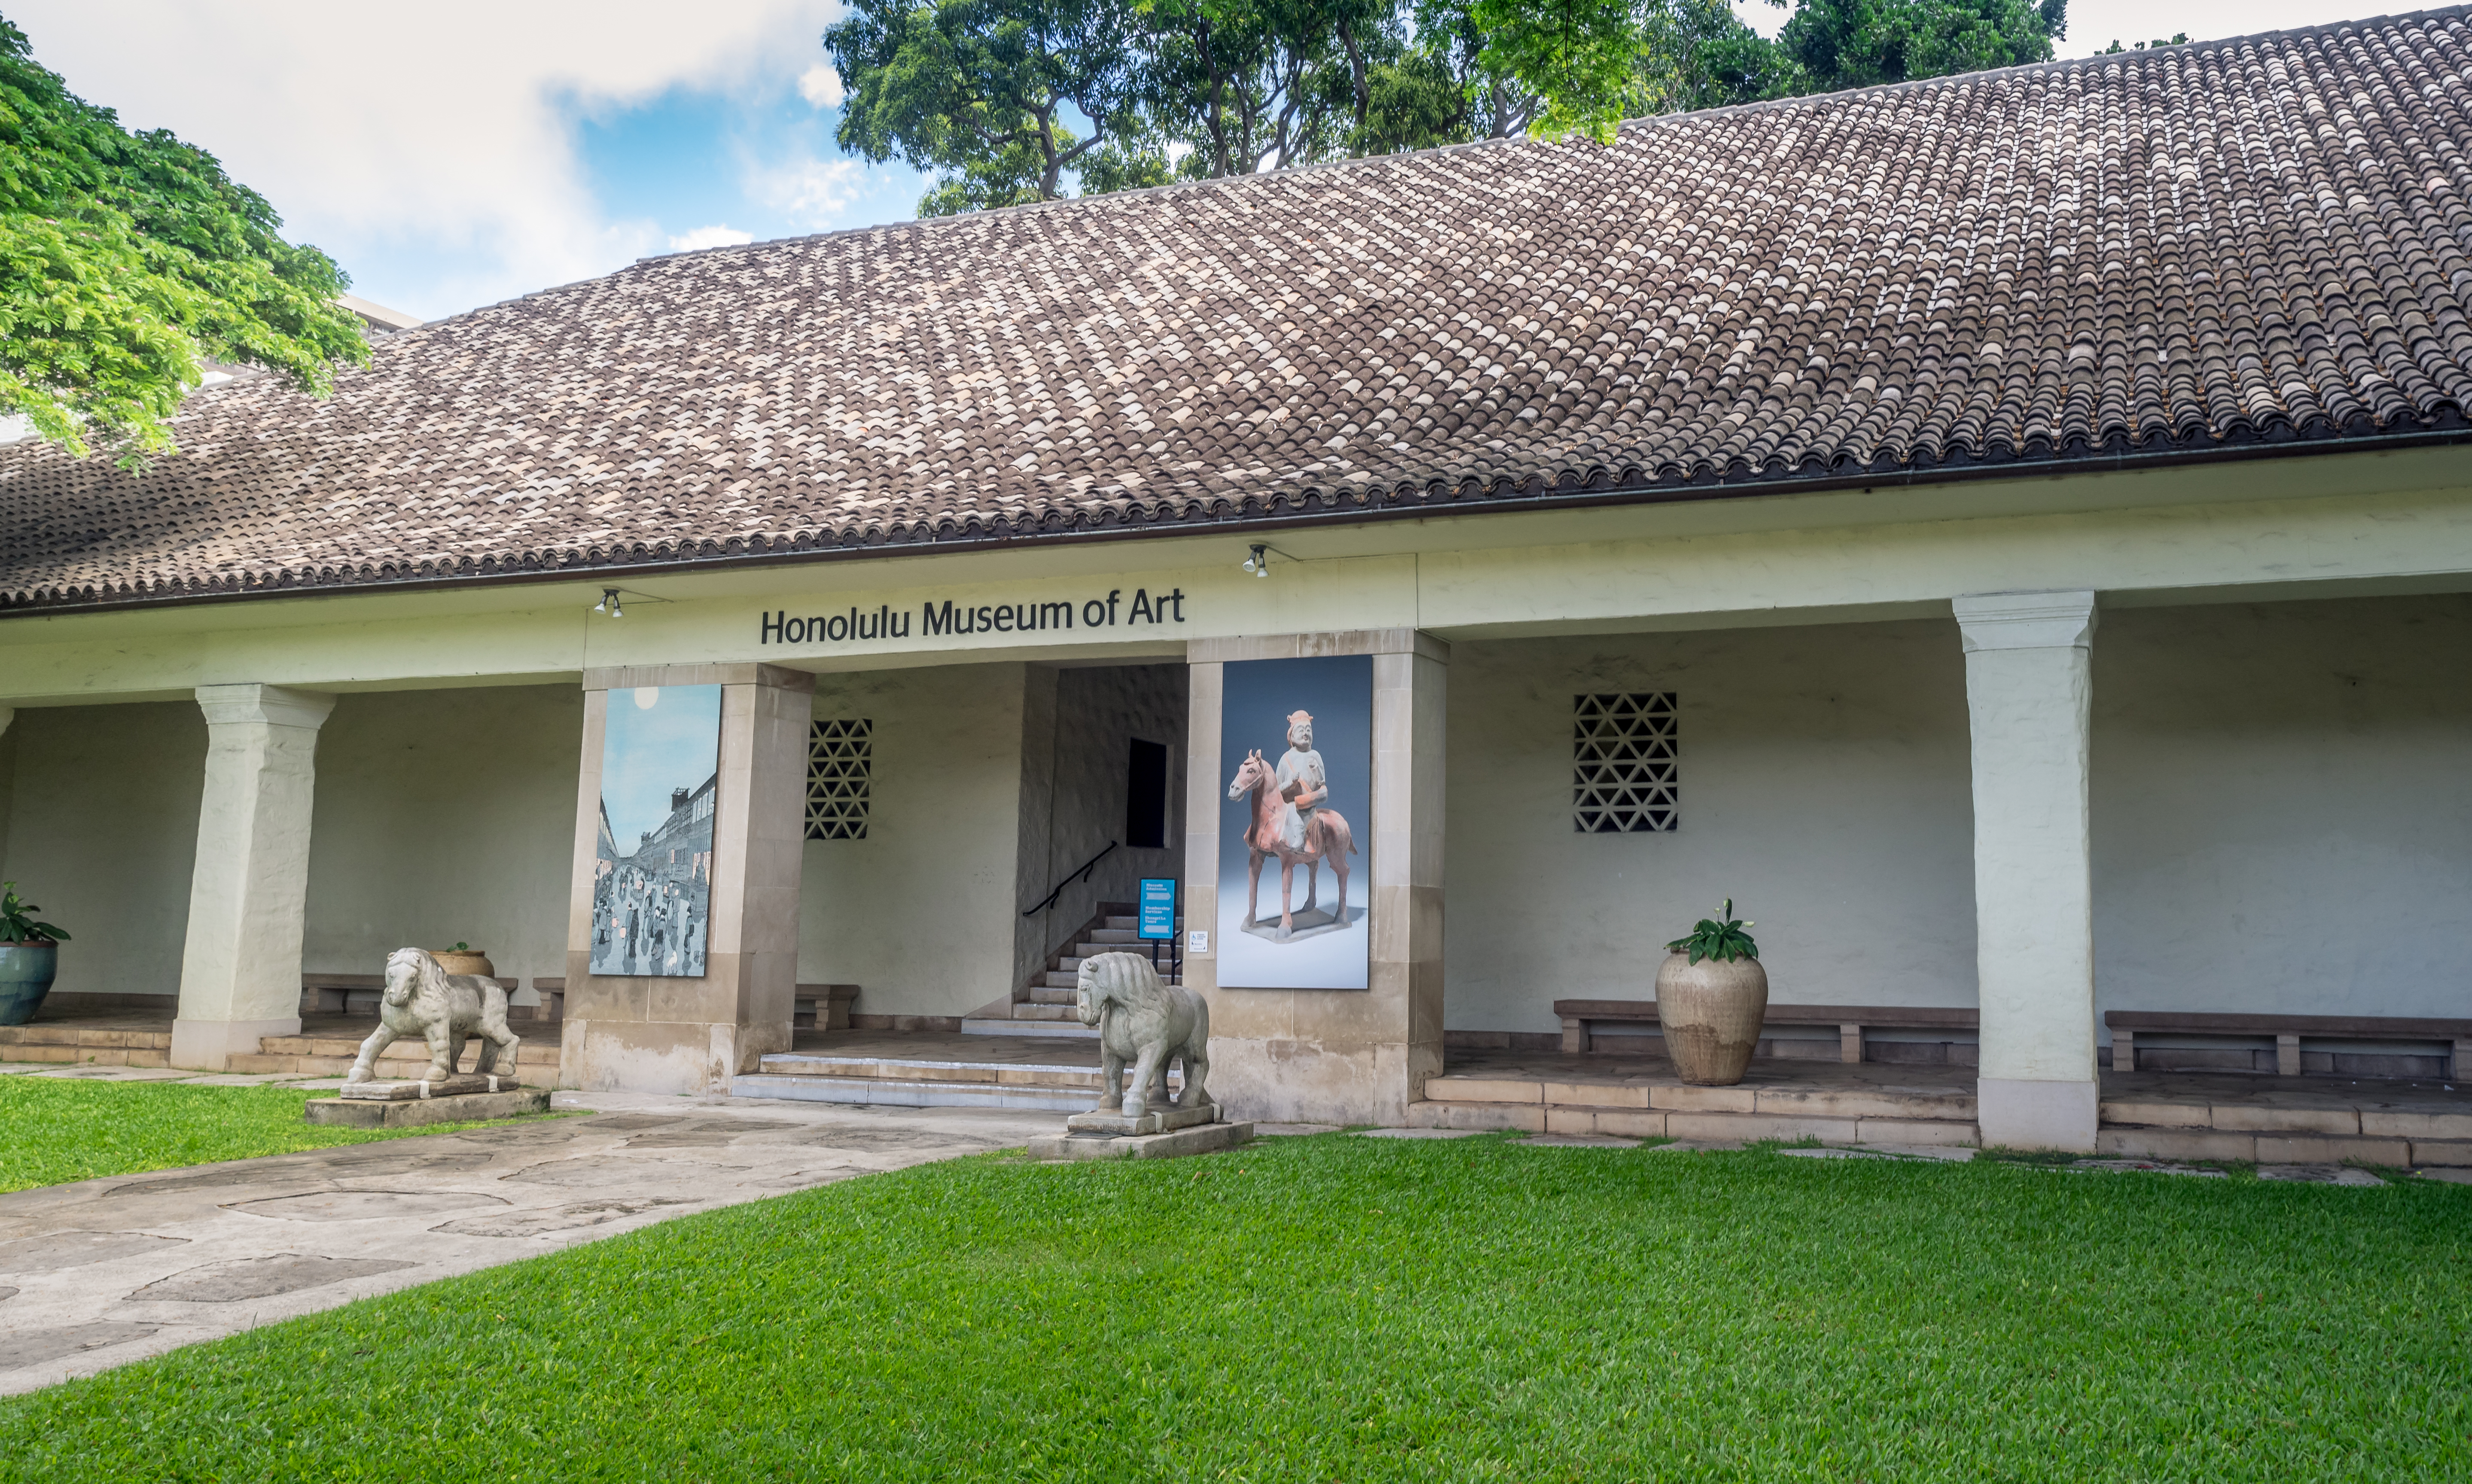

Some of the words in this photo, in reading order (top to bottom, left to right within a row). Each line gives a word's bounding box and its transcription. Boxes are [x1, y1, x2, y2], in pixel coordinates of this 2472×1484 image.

[761, 605, 910, 645] Honolulu
[923, 600, 1073, 636] Museum
[1082, 589, 1121, 627] of
[1128, 588, 1185, 625] Art
